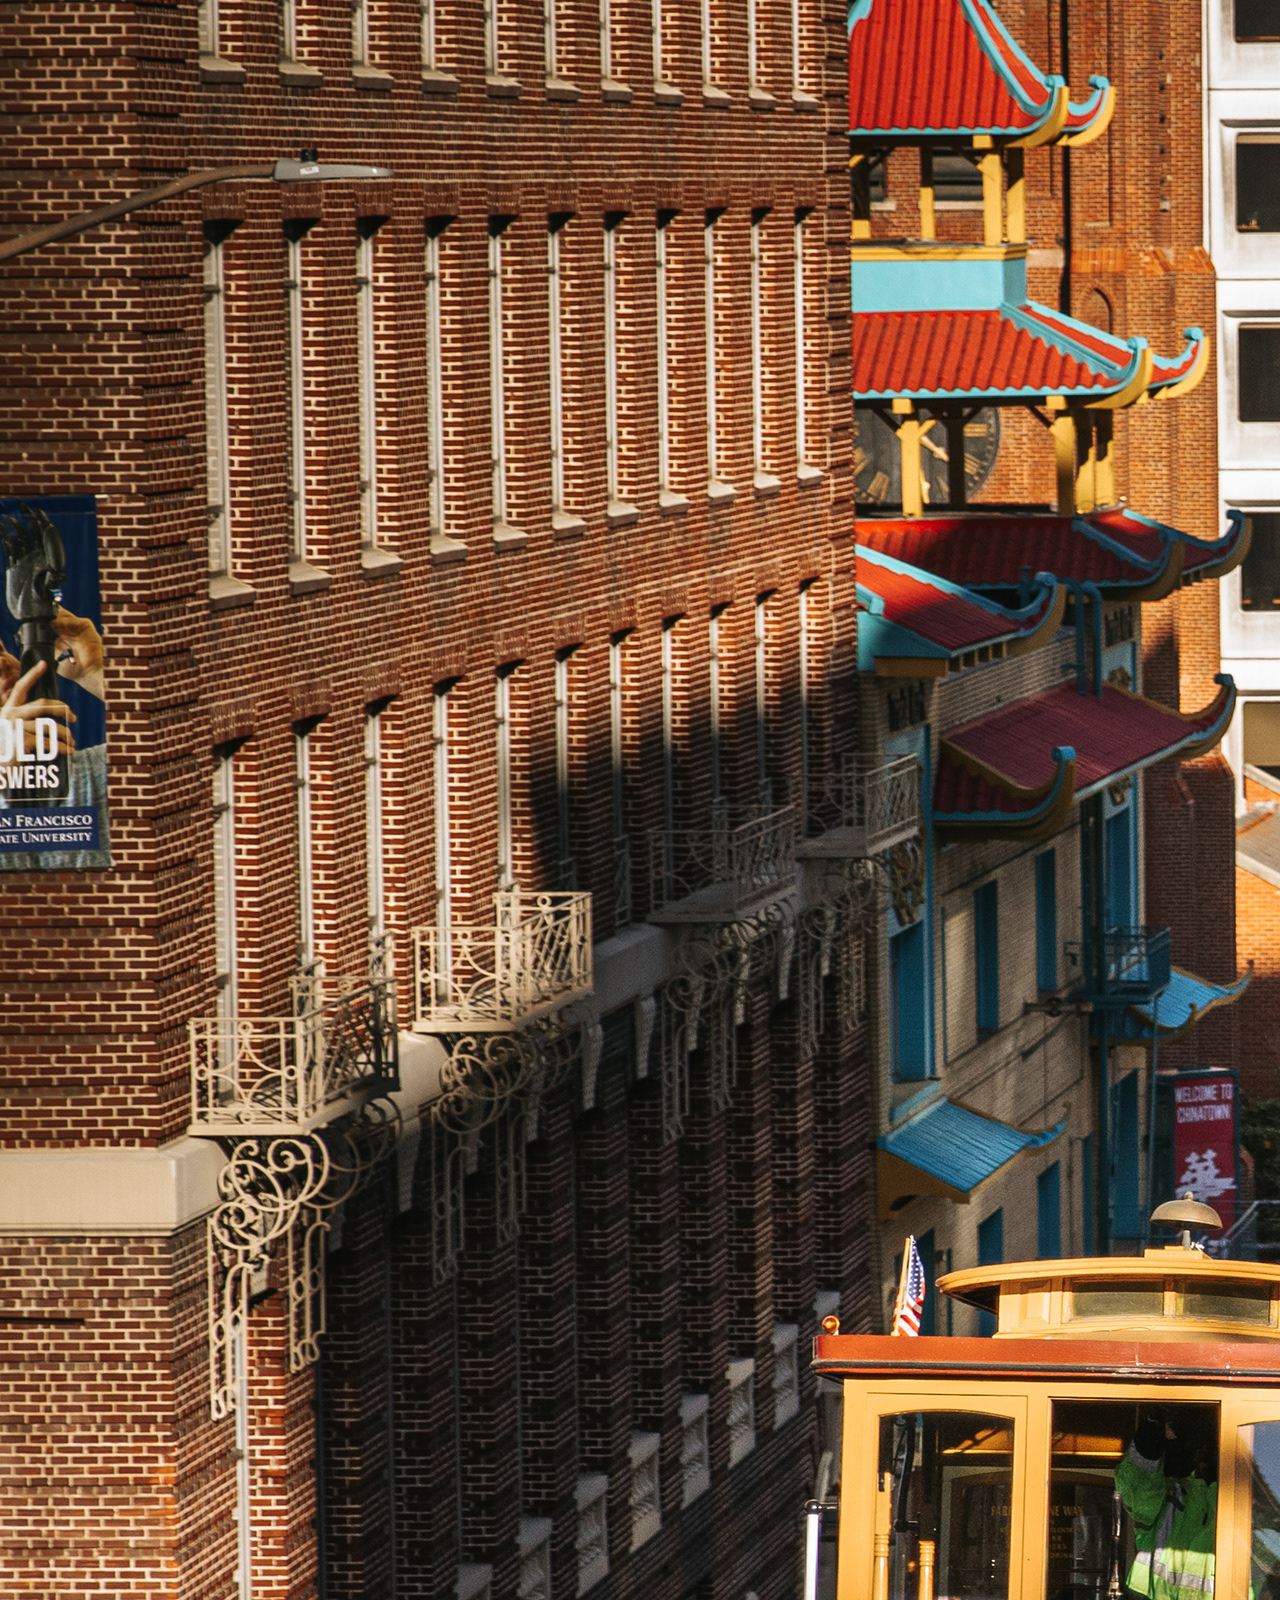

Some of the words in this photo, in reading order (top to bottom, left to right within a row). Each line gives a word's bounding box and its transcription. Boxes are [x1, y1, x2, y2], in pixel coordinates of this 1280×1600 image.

[0, 717, 58, 763] OLD
[0, 764, 60, 789] SWERS
[15, 814, 93, 828] FRANCISCO
[21, 832, 92, 843] UNIVERSITY
[1174, 1084, 1217, 1102] WELCOME
[1220, 1083, 1234, 1099] TO
[1177, 1104, 1231, 1123] CHINATOWN
